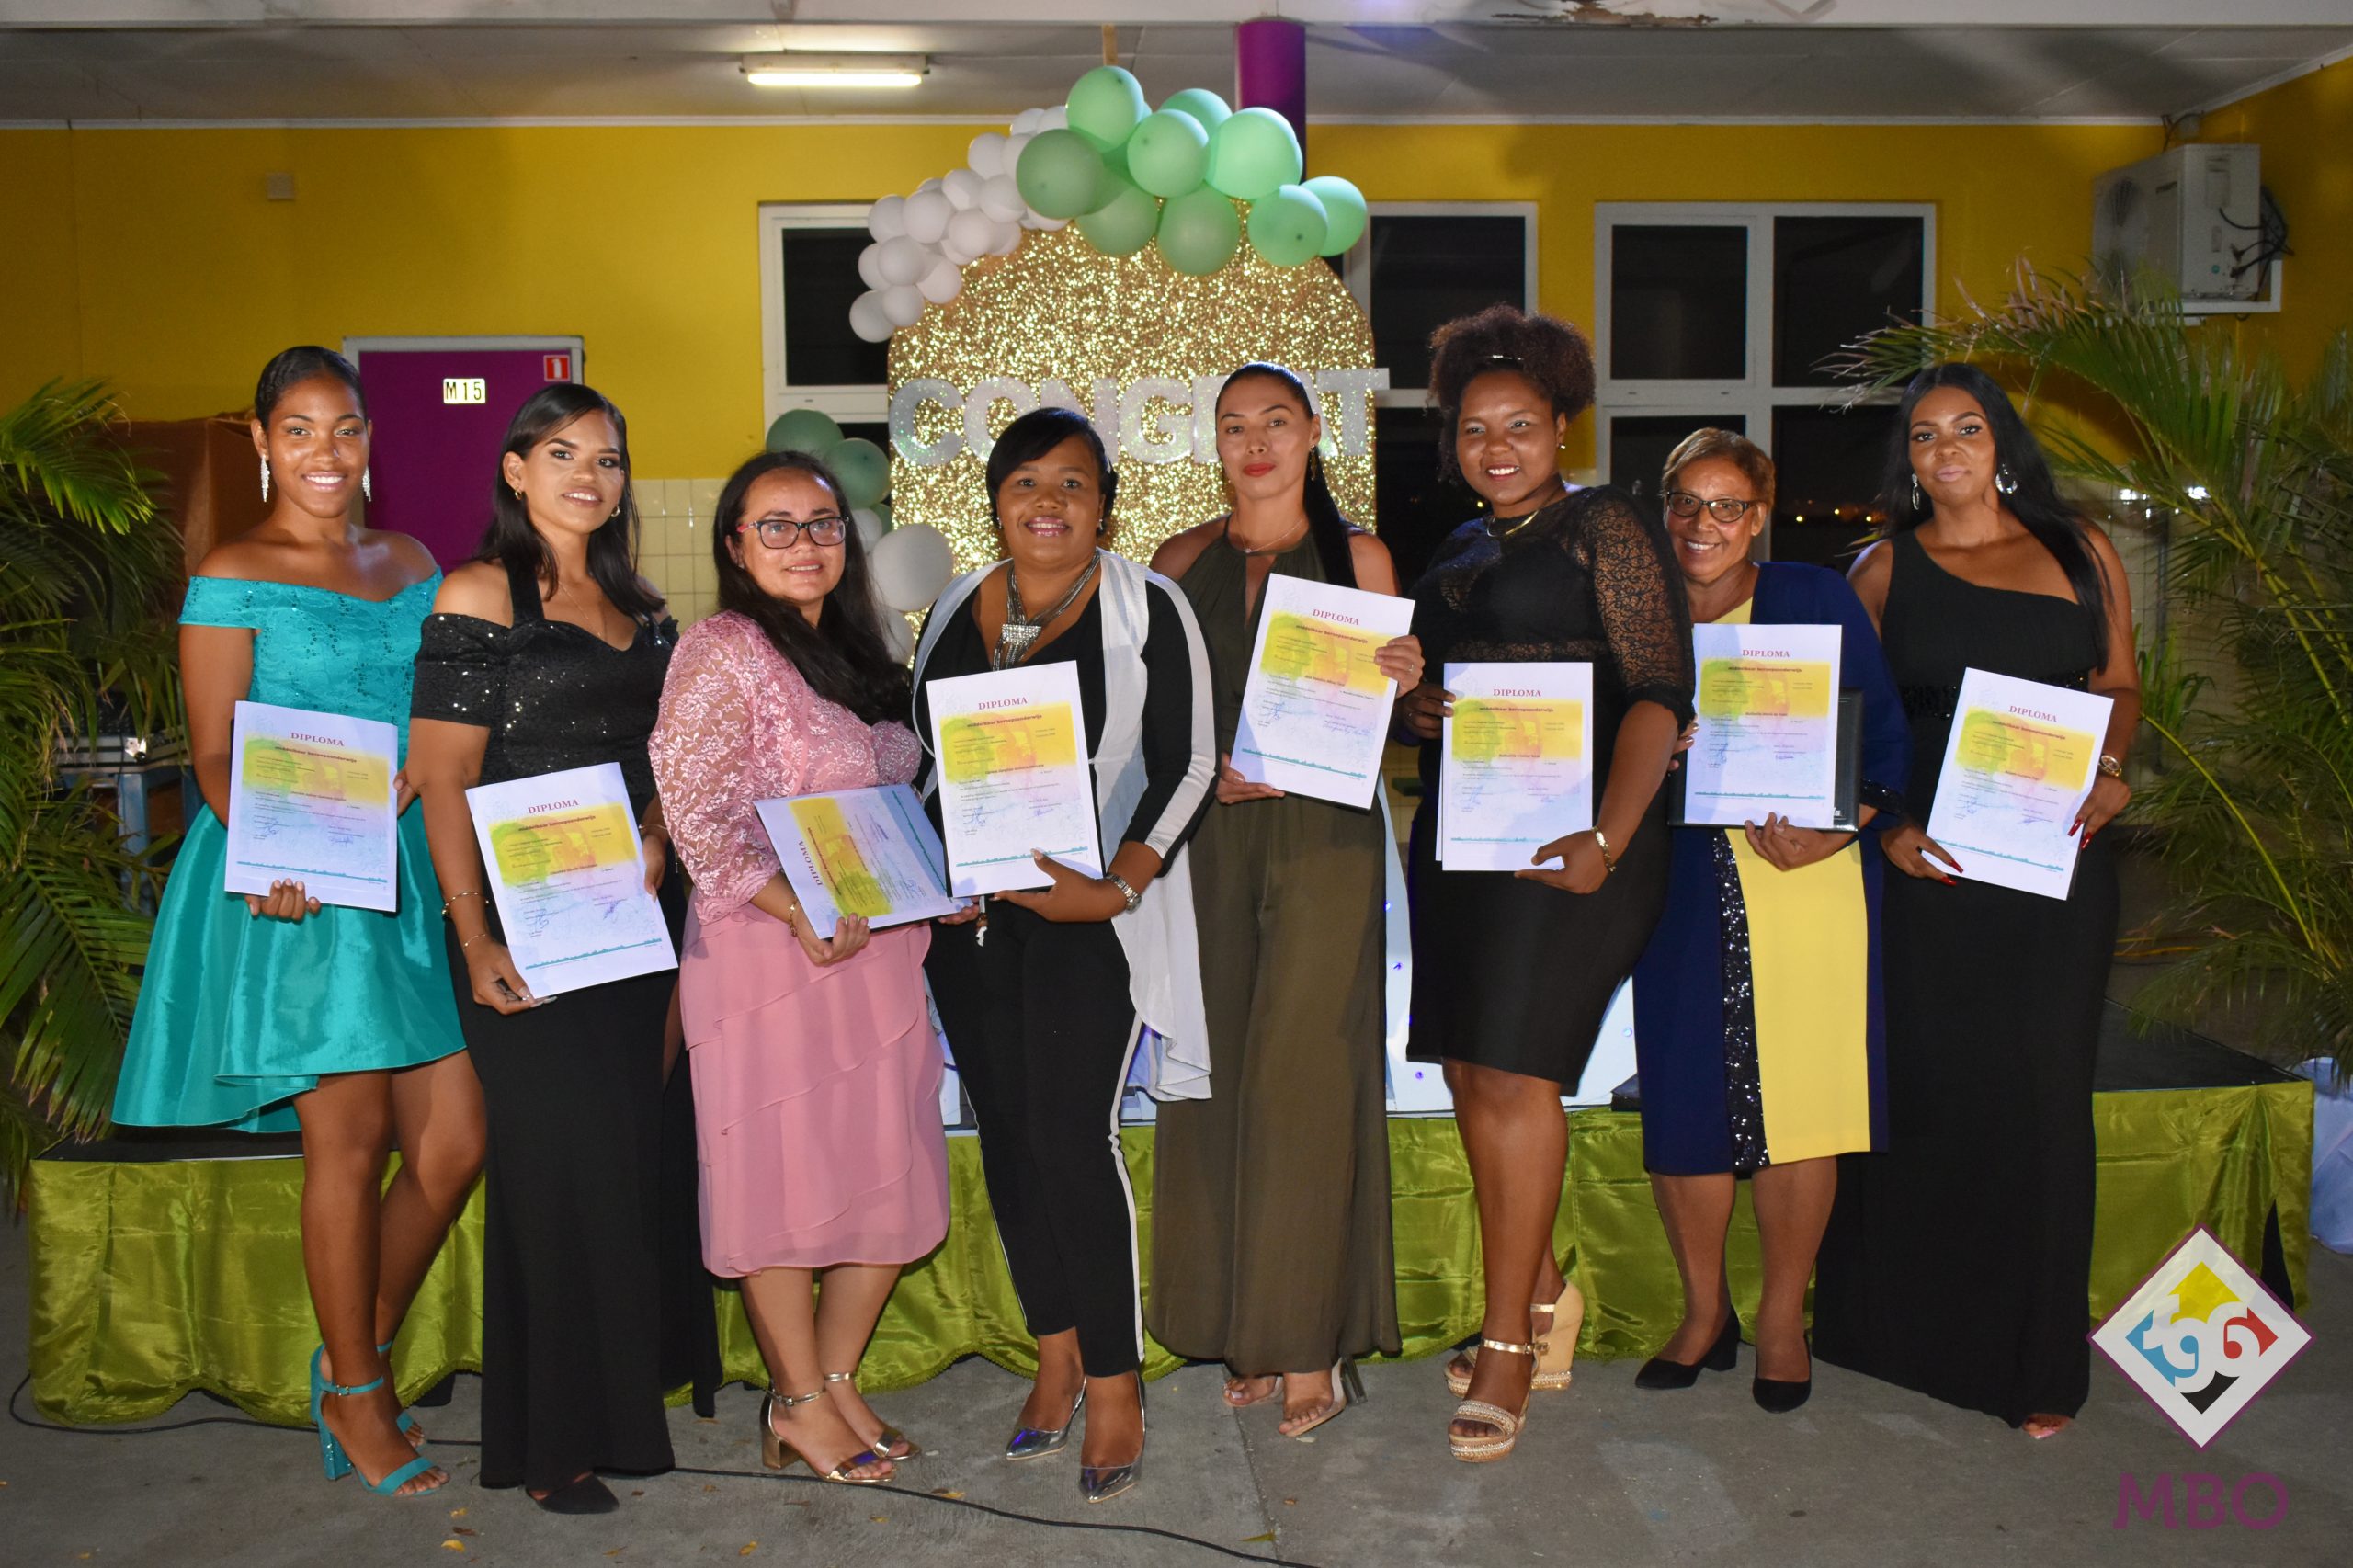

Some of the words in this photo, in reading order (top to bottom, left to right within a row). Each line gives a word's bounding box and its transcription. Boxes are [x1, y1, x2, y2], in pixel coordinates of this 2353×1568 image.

[1313, 608, 1359, 626] DIPLOMA
[1742, 649, 1790, 658] DIPLOMA
[1493, 688, 1542, 697] DIPLOMA
[978, 697, 1028, 710] DIPLOMA
[2009, 705, 2058, 722] DIPLOMA
[290, 732, 345, 747] DIPLOMA
[528, 799, 579, 814] DIPLOMA
[798, 840, 824, 886] DIPLOMA
